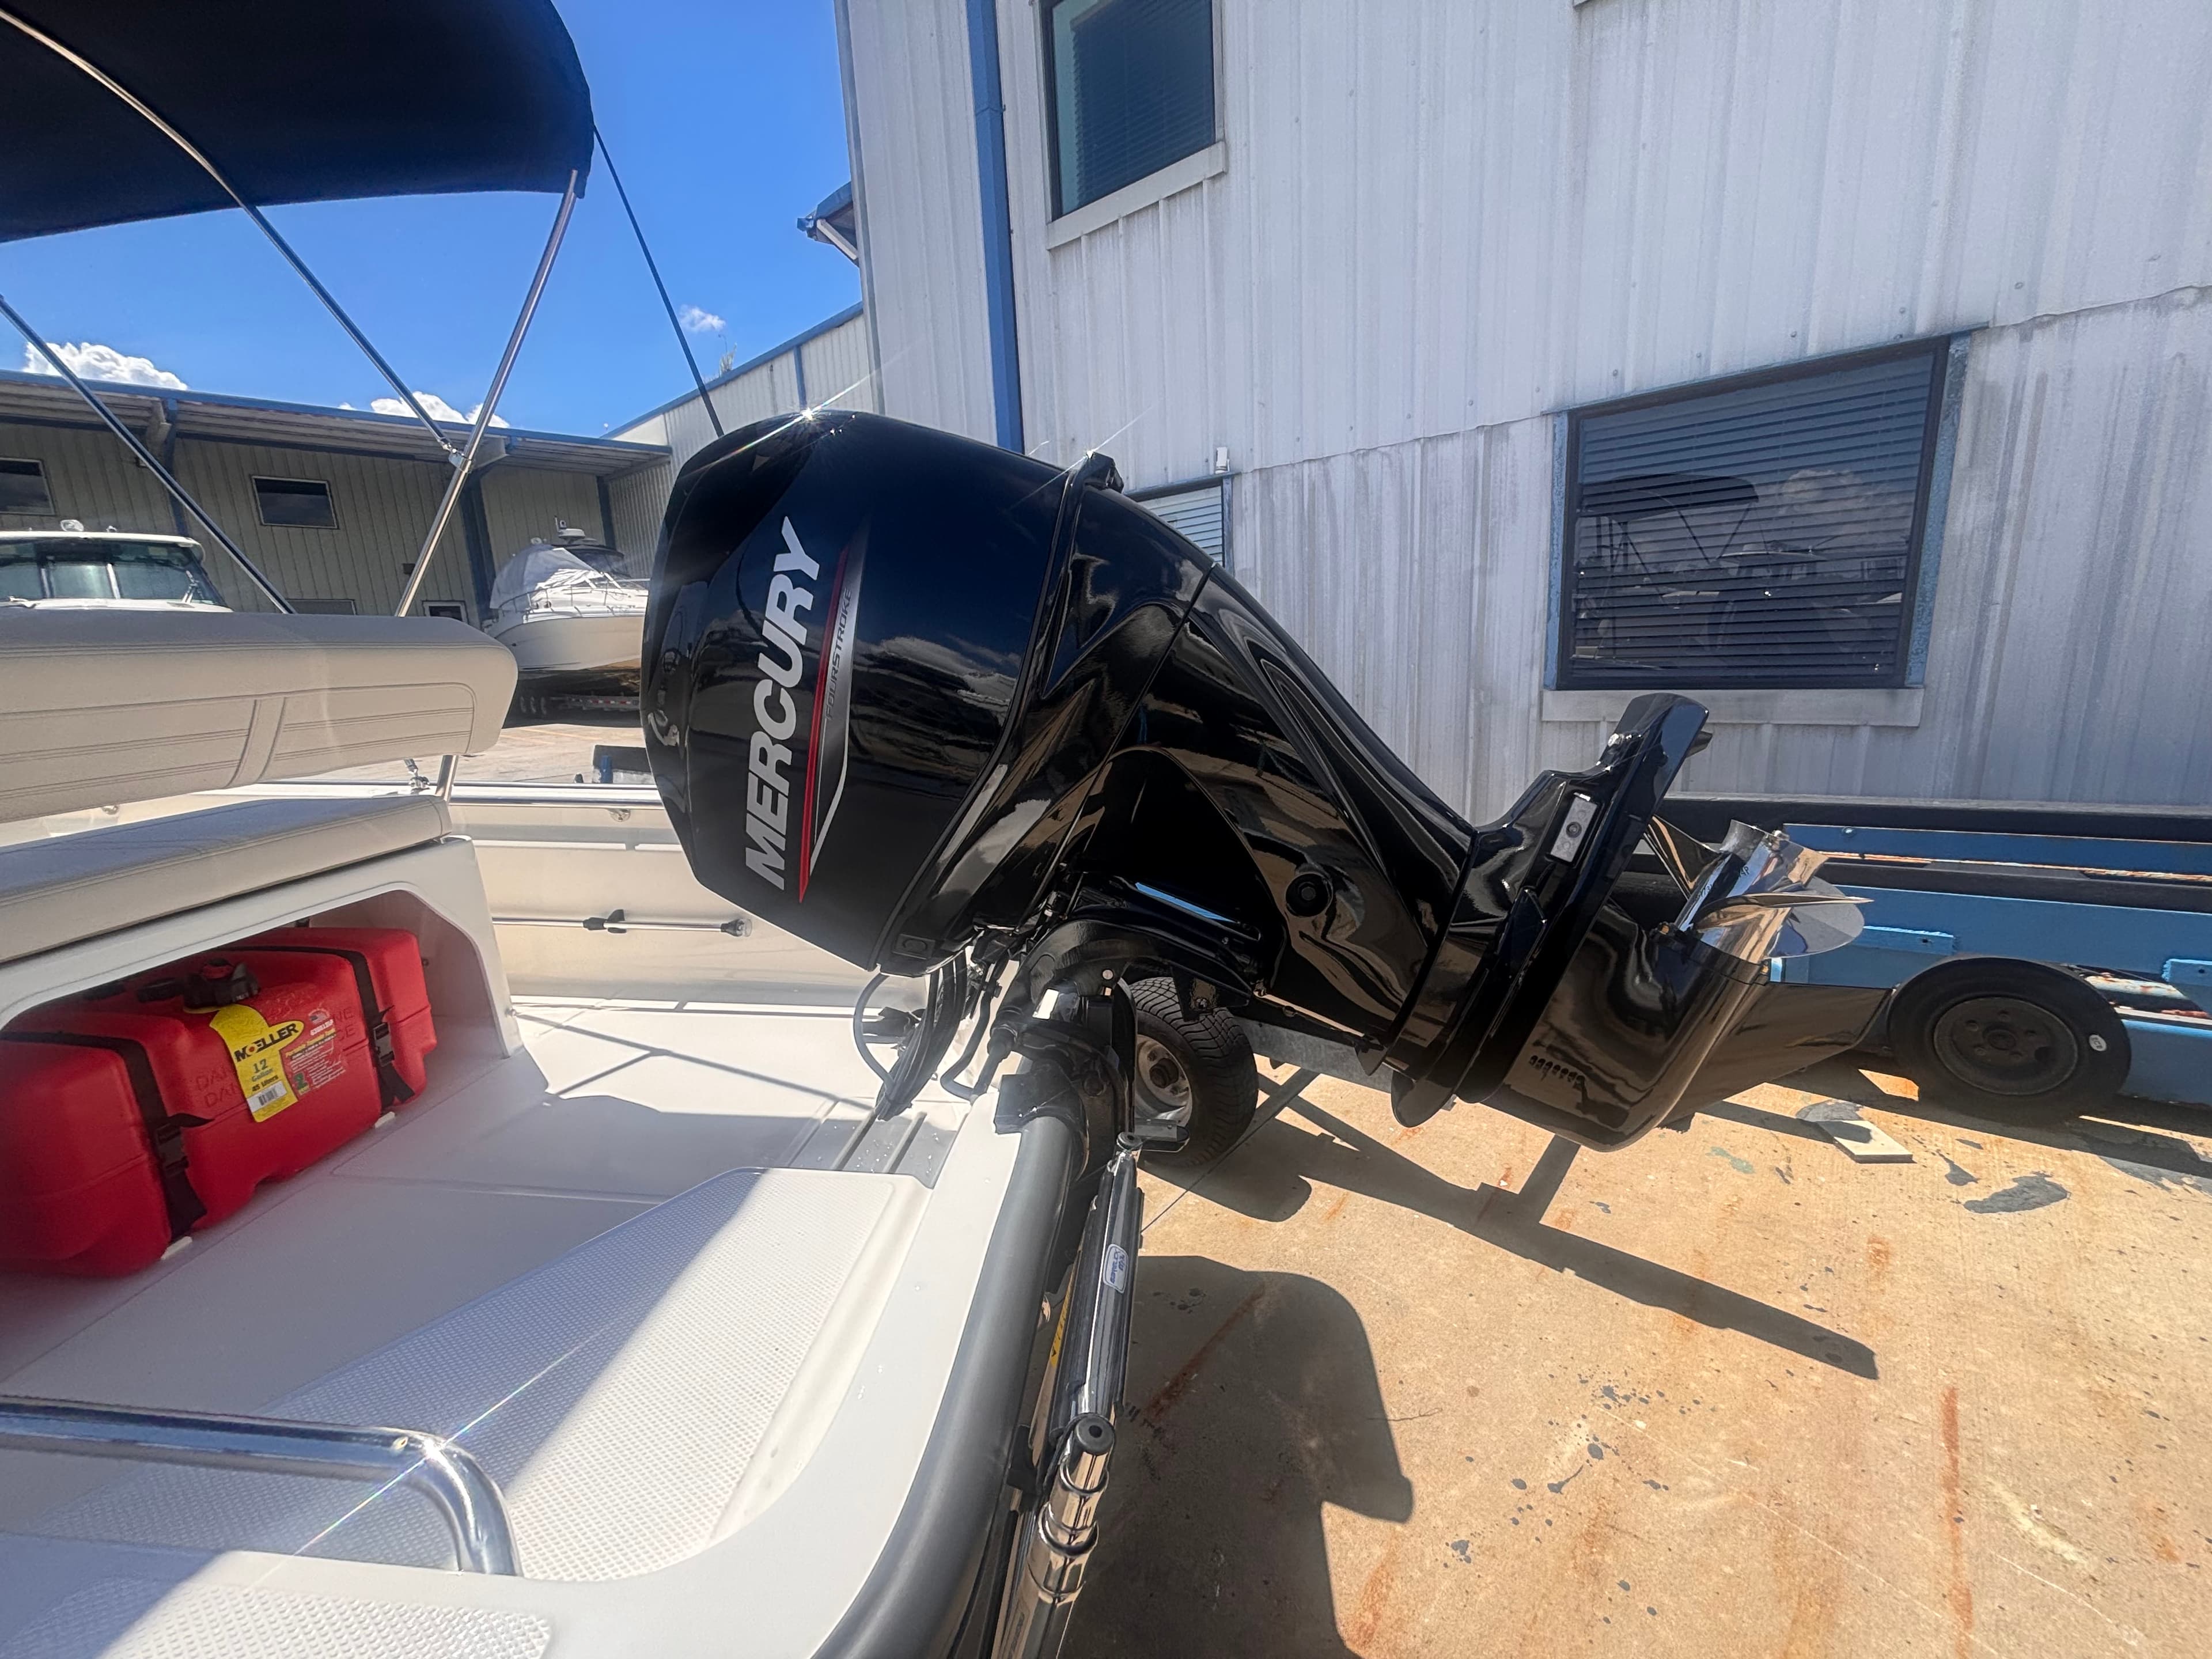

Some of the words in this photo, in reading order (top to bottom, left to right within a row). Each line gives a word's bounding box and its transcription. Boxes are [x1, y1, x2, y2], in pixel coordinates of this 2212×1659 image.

[825, 588, 852, 719] FOURSTROKE
[745, 516, 820, 891] MERCURY
[234, 1023, 299, 1063] MOELLER
[252, 1058, 268, 1074] 12
